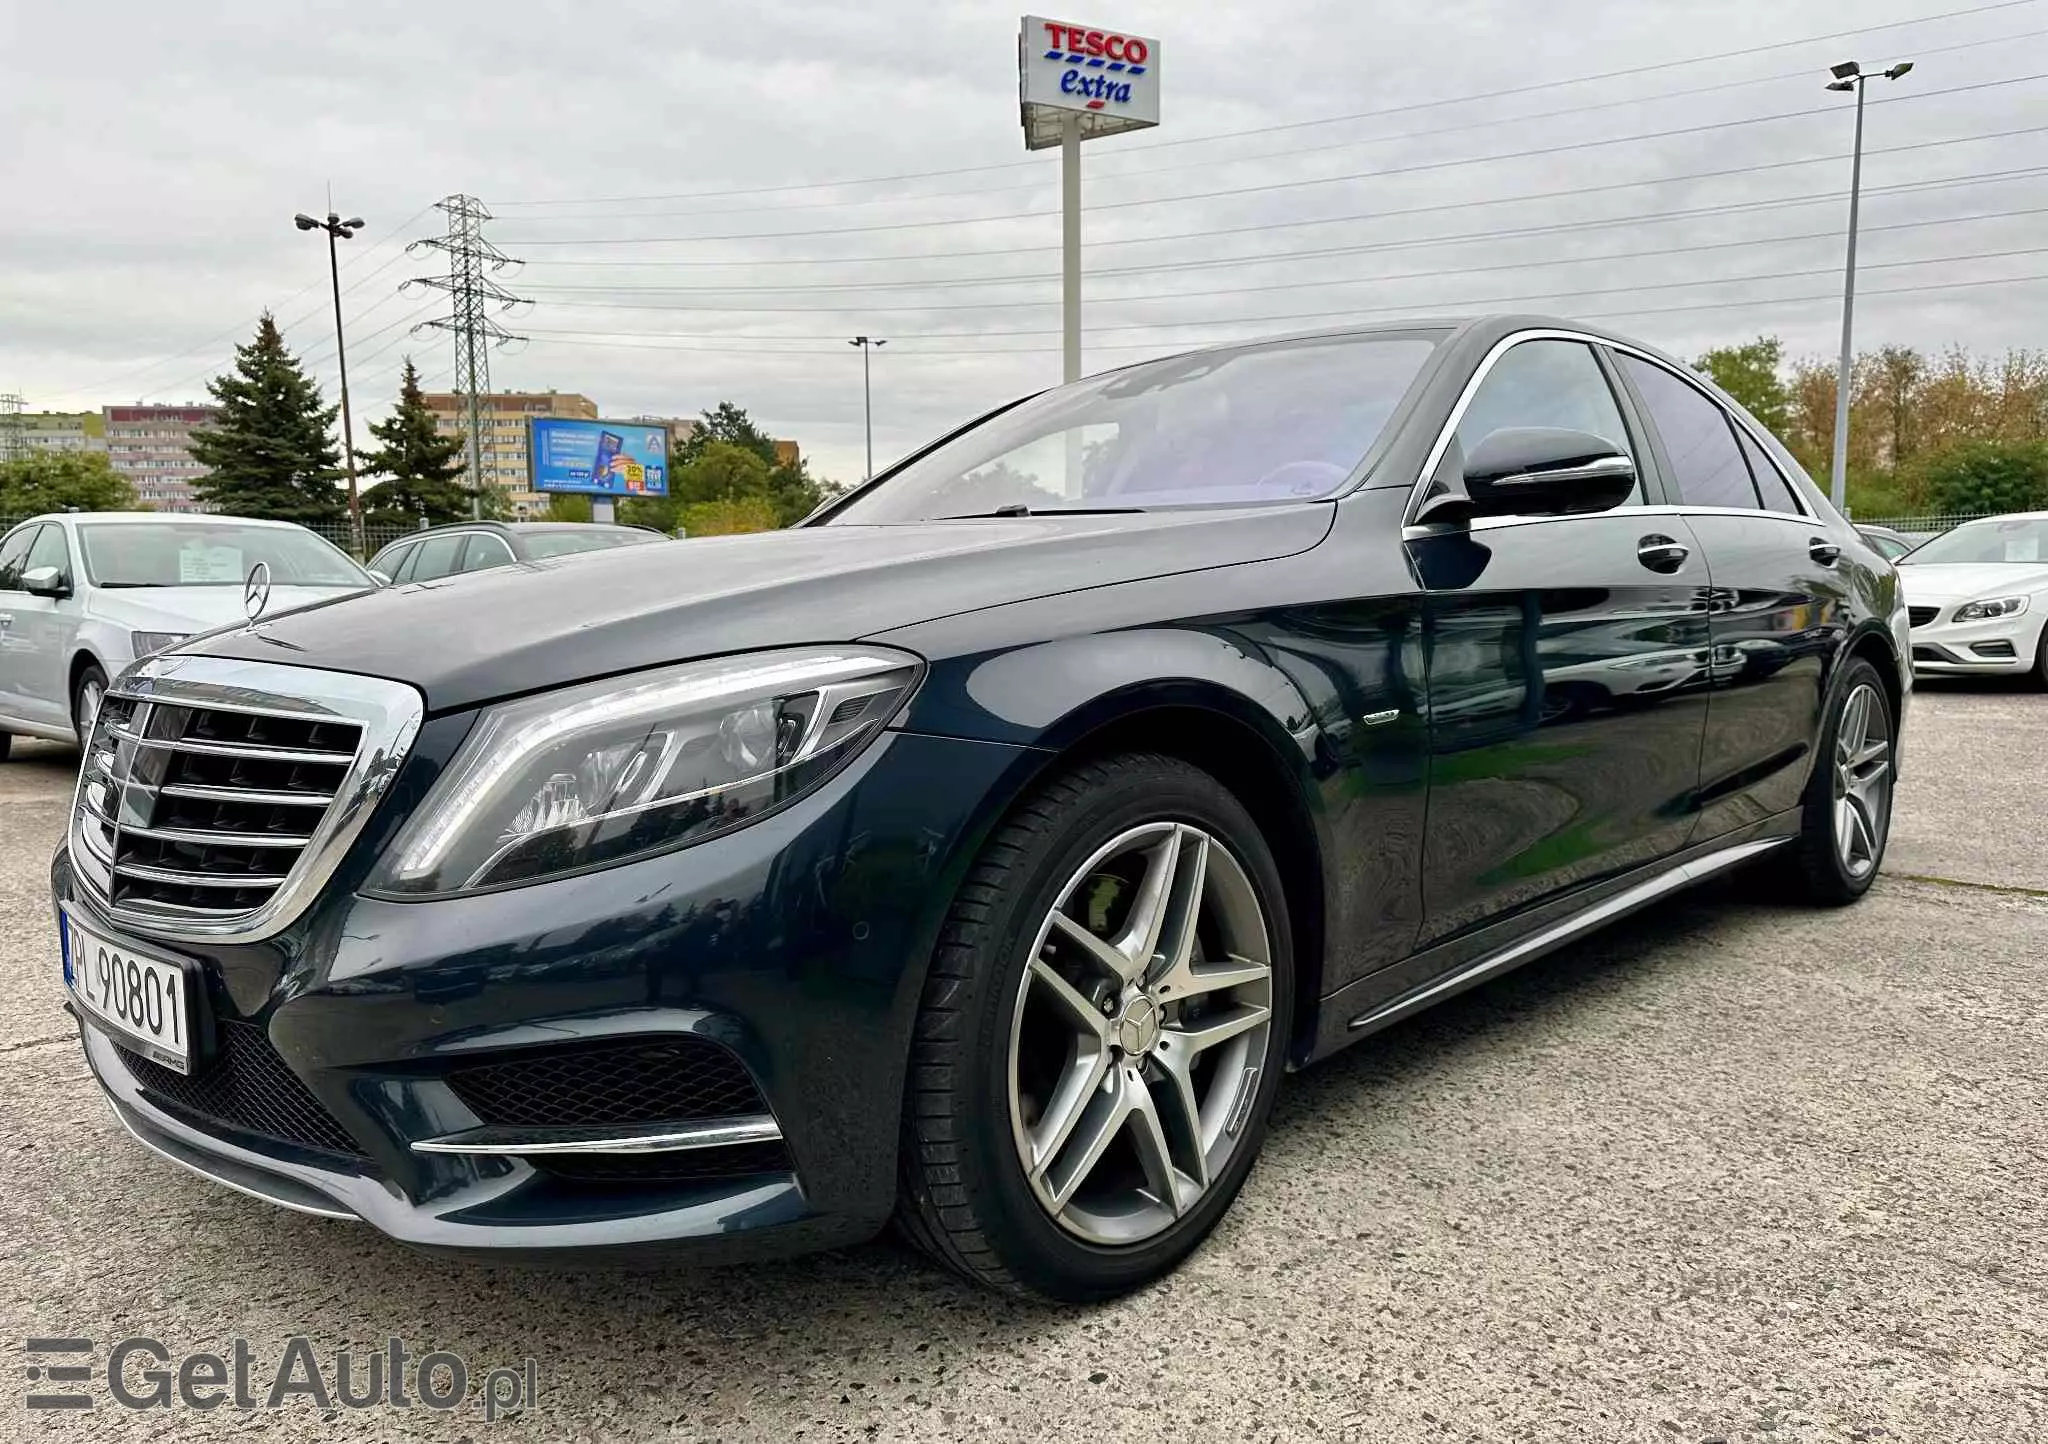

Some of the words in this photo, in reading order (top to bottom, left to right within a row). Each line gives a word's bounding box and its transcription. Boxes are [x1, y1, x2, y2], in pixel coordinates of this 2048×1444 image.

[1044, 24, 1147, 63] TESCO
[1061, 70, 1132, 102] extra
[98, 947, 179, 1044] 90801
